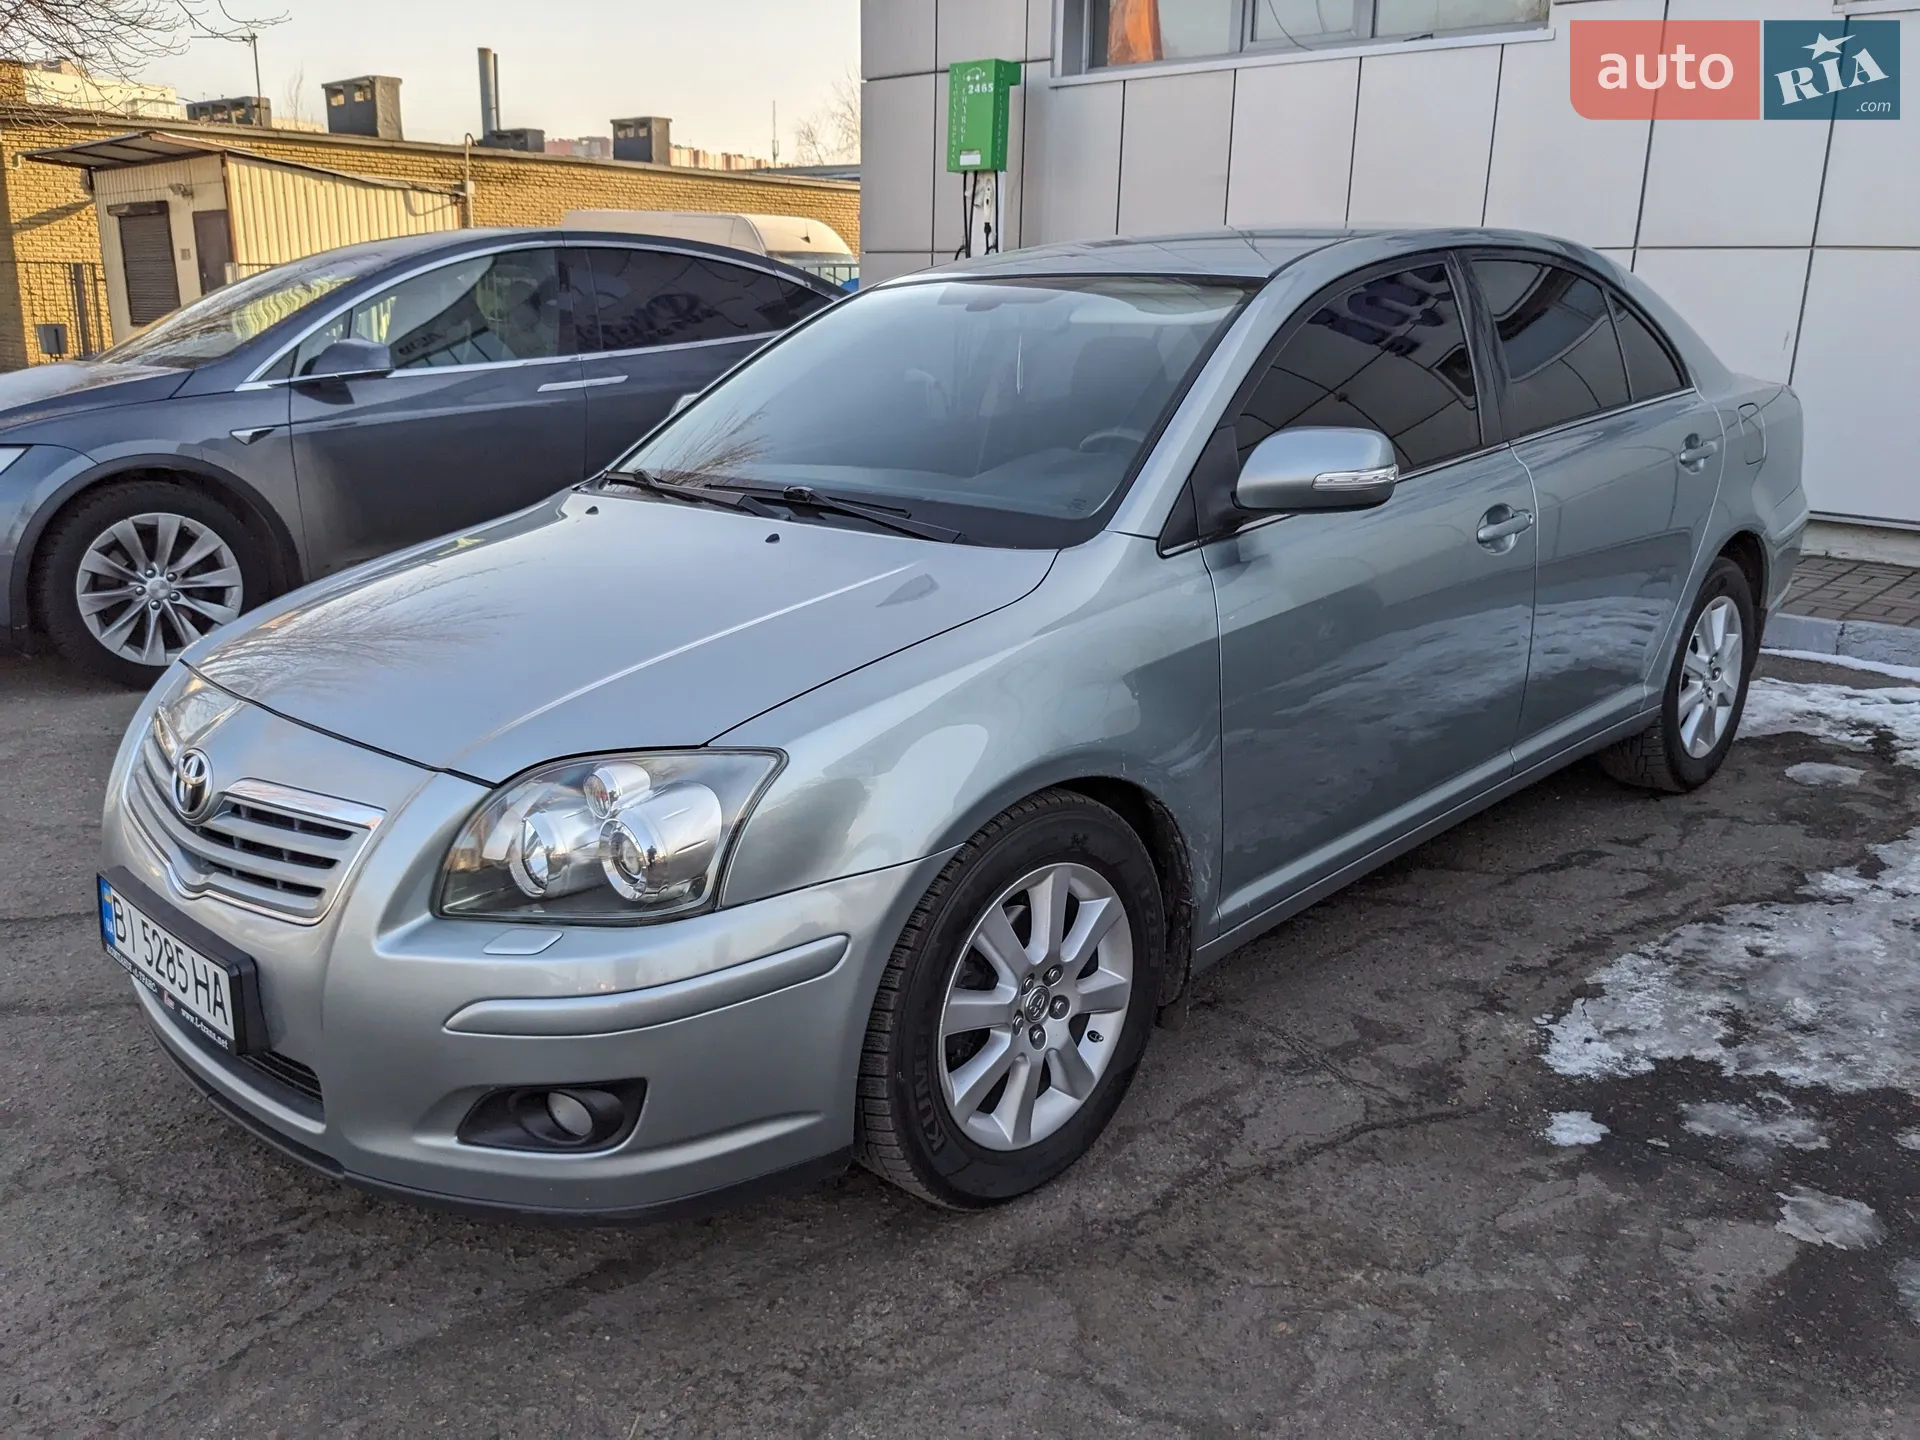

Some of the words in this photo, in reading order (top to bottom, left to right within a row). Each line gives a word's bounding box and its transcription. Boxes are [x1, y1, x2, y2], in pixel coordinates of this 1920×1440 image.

[968, 83, 993, 94] 2465
[105, 918, 114, 936] UA
[112, 895, 134, 953] BI
[141, 919, 187, 994] 5285
[191, 956, 228, 1025] HA
